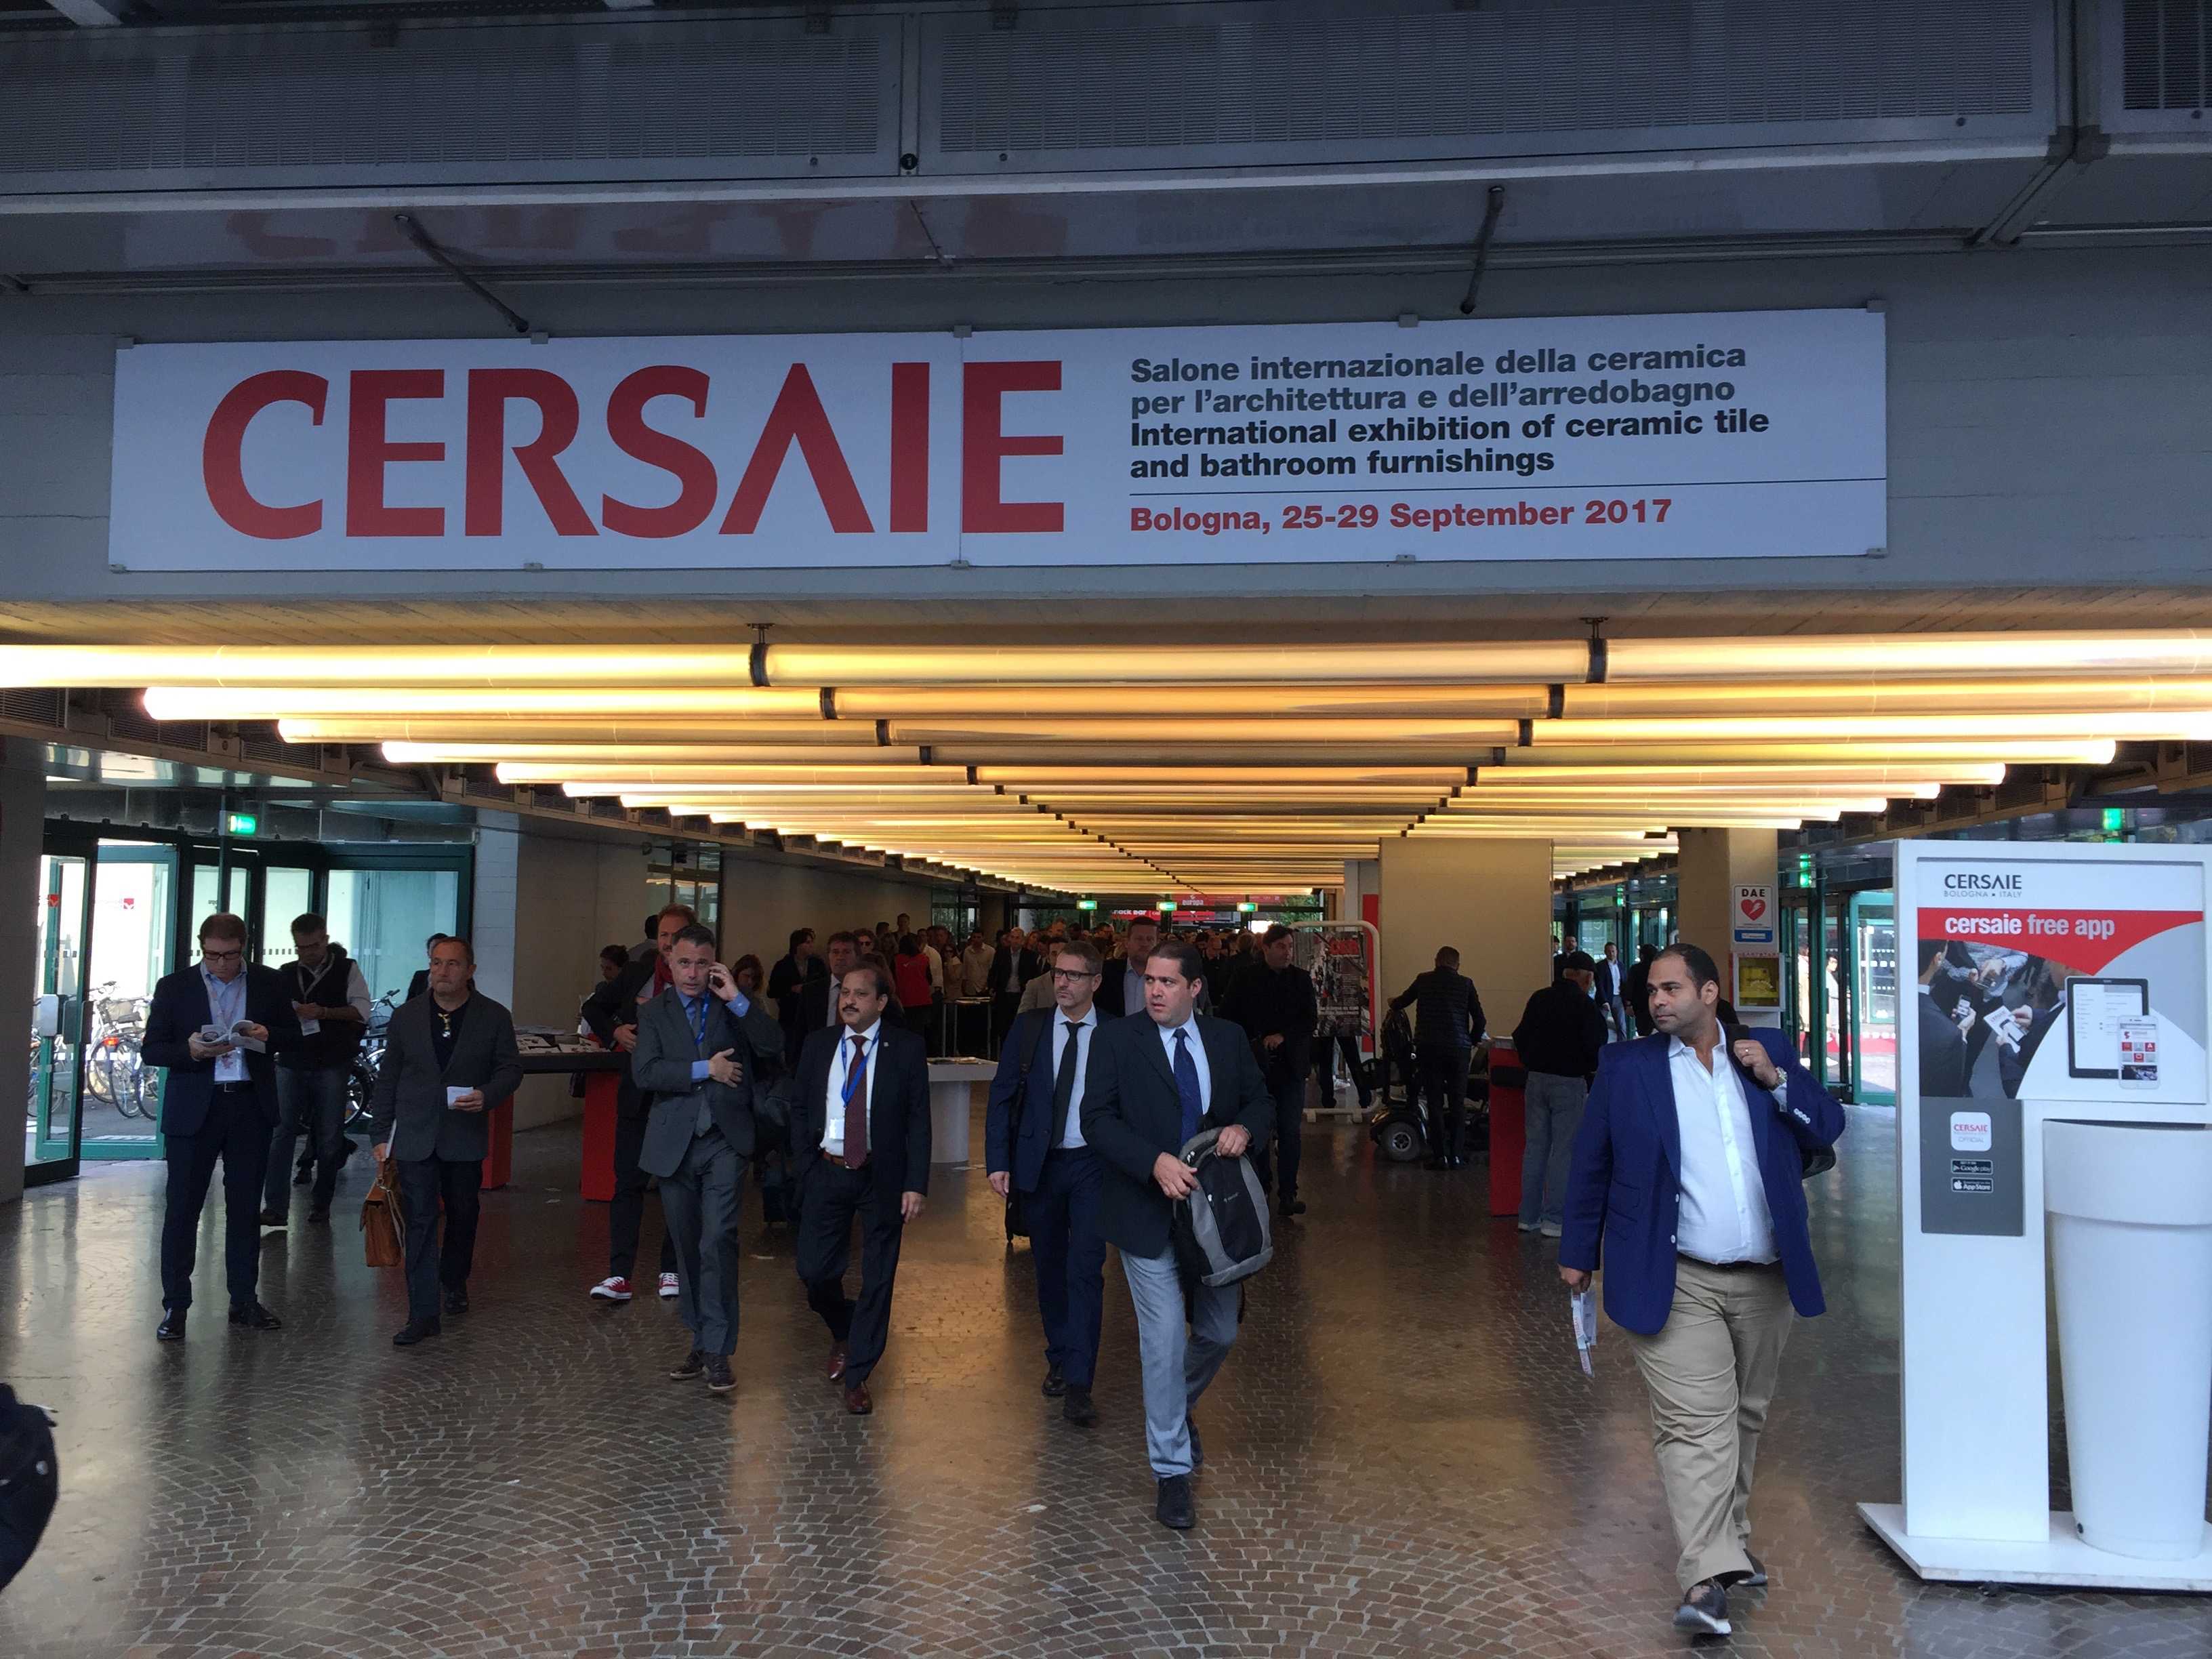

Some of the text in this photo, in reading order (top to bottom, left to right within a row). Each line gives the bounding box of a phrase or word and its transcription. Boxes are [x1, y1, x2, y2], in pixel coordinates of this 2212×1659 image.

[1131, 344, 1746, 382] Salone internazionale della ceramica
[1132, 396, 1185, 419] per
[1418, 390, 1437, 408] e
[1131, 409, 1769, 446] International exhibition of ceramic tile
[203, 361, 1064, 539] CERSAIE
[1130, 448, 1554, 478] and bathroom furnishings
[1131, 499, 1671, 535] Bologna, 25-29 September 2017
[1742, 888, 1765, 897] DAE
[1945, 874, 2022, 889] CERSAIE
[1945, 914, 2115, 940] cersaie free app
[1954, 1124, 1988, 1132] CERSAIE
